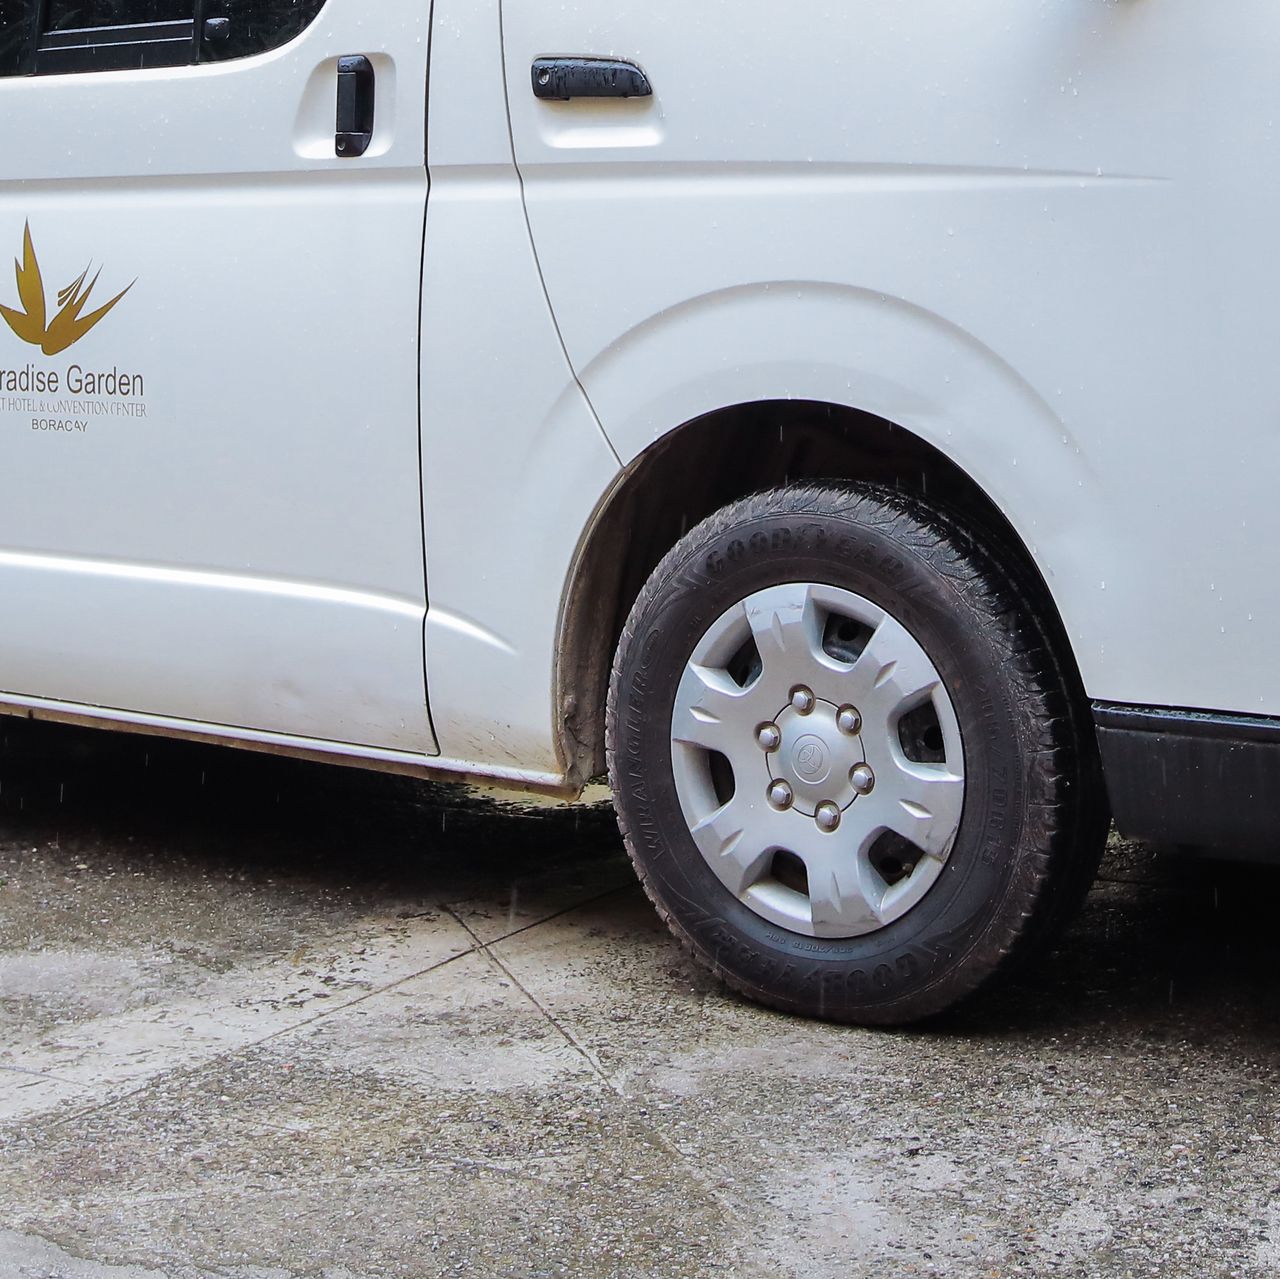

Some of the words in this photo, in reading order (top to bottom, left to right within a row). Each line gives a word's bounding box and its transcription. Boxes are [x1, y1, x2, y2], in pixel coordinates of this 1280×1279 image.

[66, 364, 144, 396] Garden
[8, 398, 38, 413] HOTEL
[46, 400, 109, 416] CONVENTION
[31, 418, 88, 432] BORACAY
[705, 522, 906, 577] GOODYEAR
